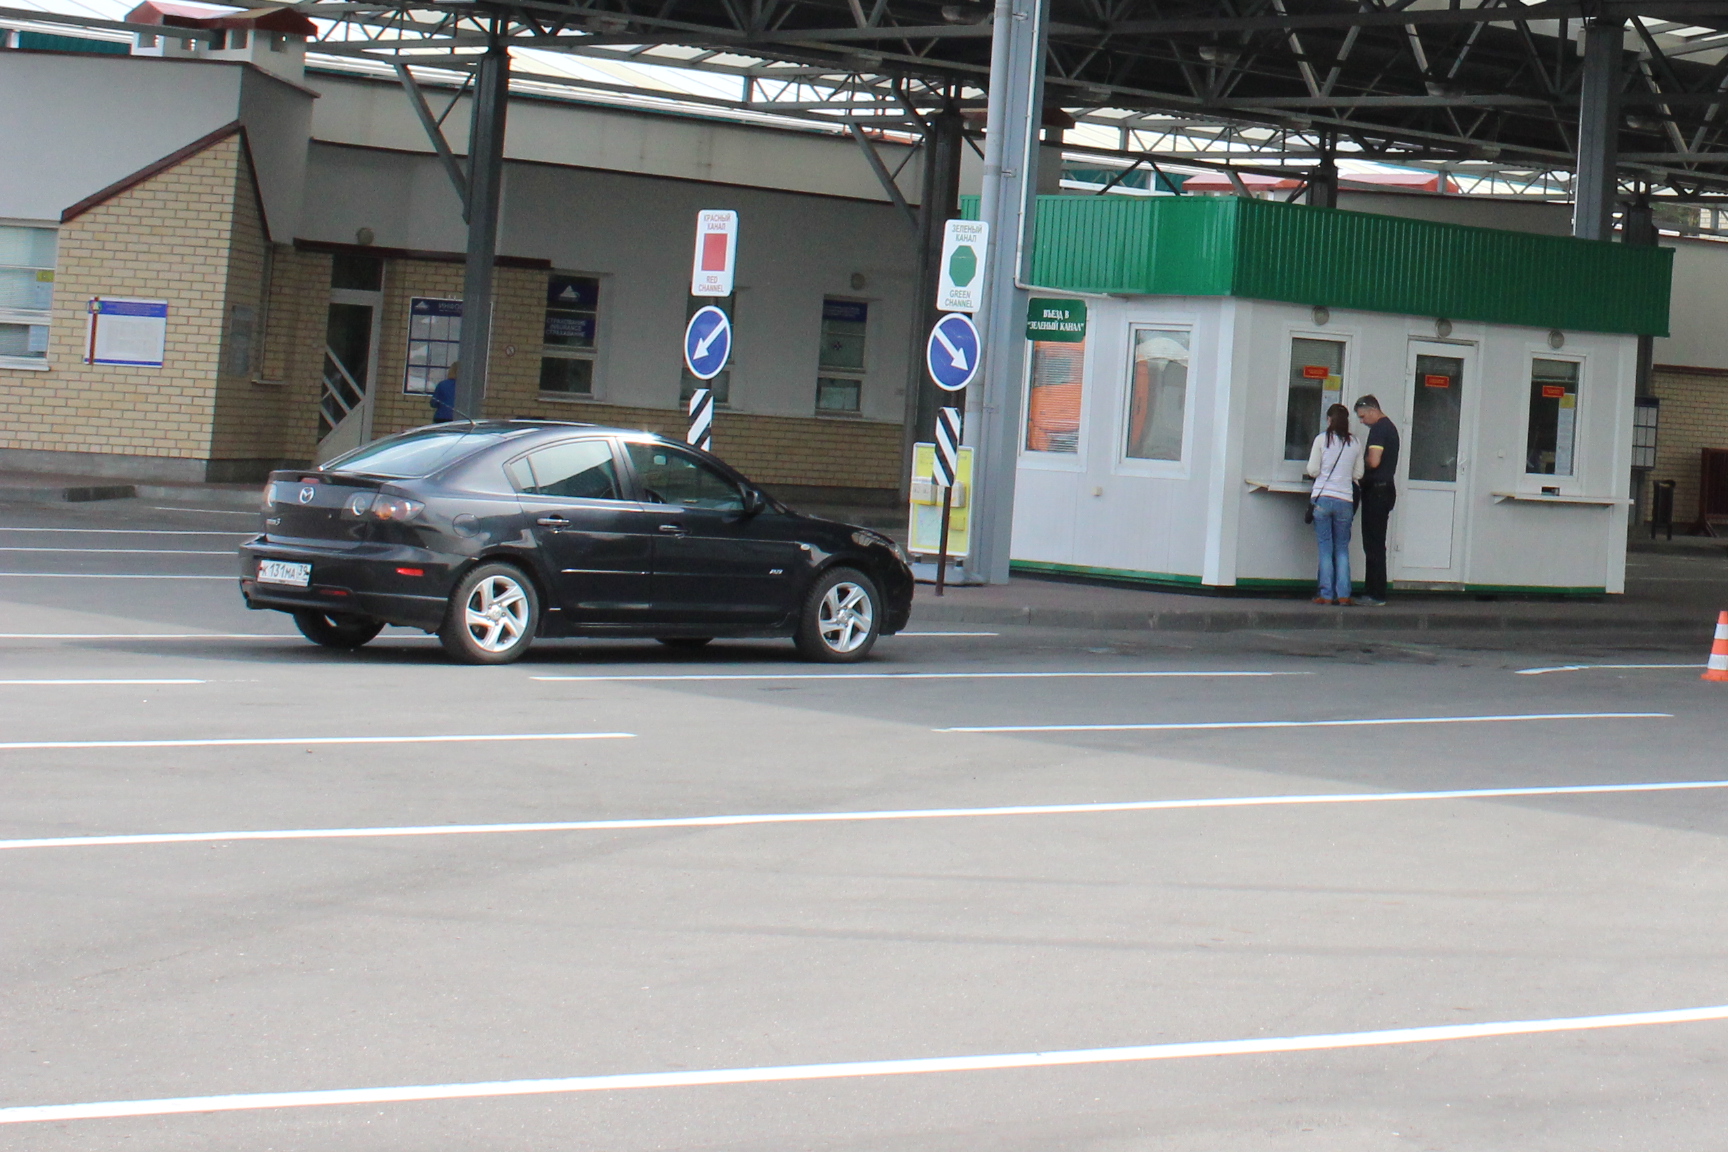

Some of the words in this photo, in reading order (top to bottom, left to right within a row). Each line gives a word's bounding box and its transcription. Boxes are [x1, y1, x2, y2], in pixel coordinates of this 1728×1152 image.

[703, 213, 731, 222] КРАСНЫЙ
[707, 222, 726, 230] КАНАЛ
[952, 224, 983, 234] ЗЕЛЕНЫЙ
[955, 233, 977, 243] КАНАЛ
[706, 275, 719, 284] RED
[698, 283, 725, 293] CHANNEL
[949, 289, 972, 299] GREEN
[944, 298, 974, 308] CHANNEL
[1064, 310, 1070, 319] В
